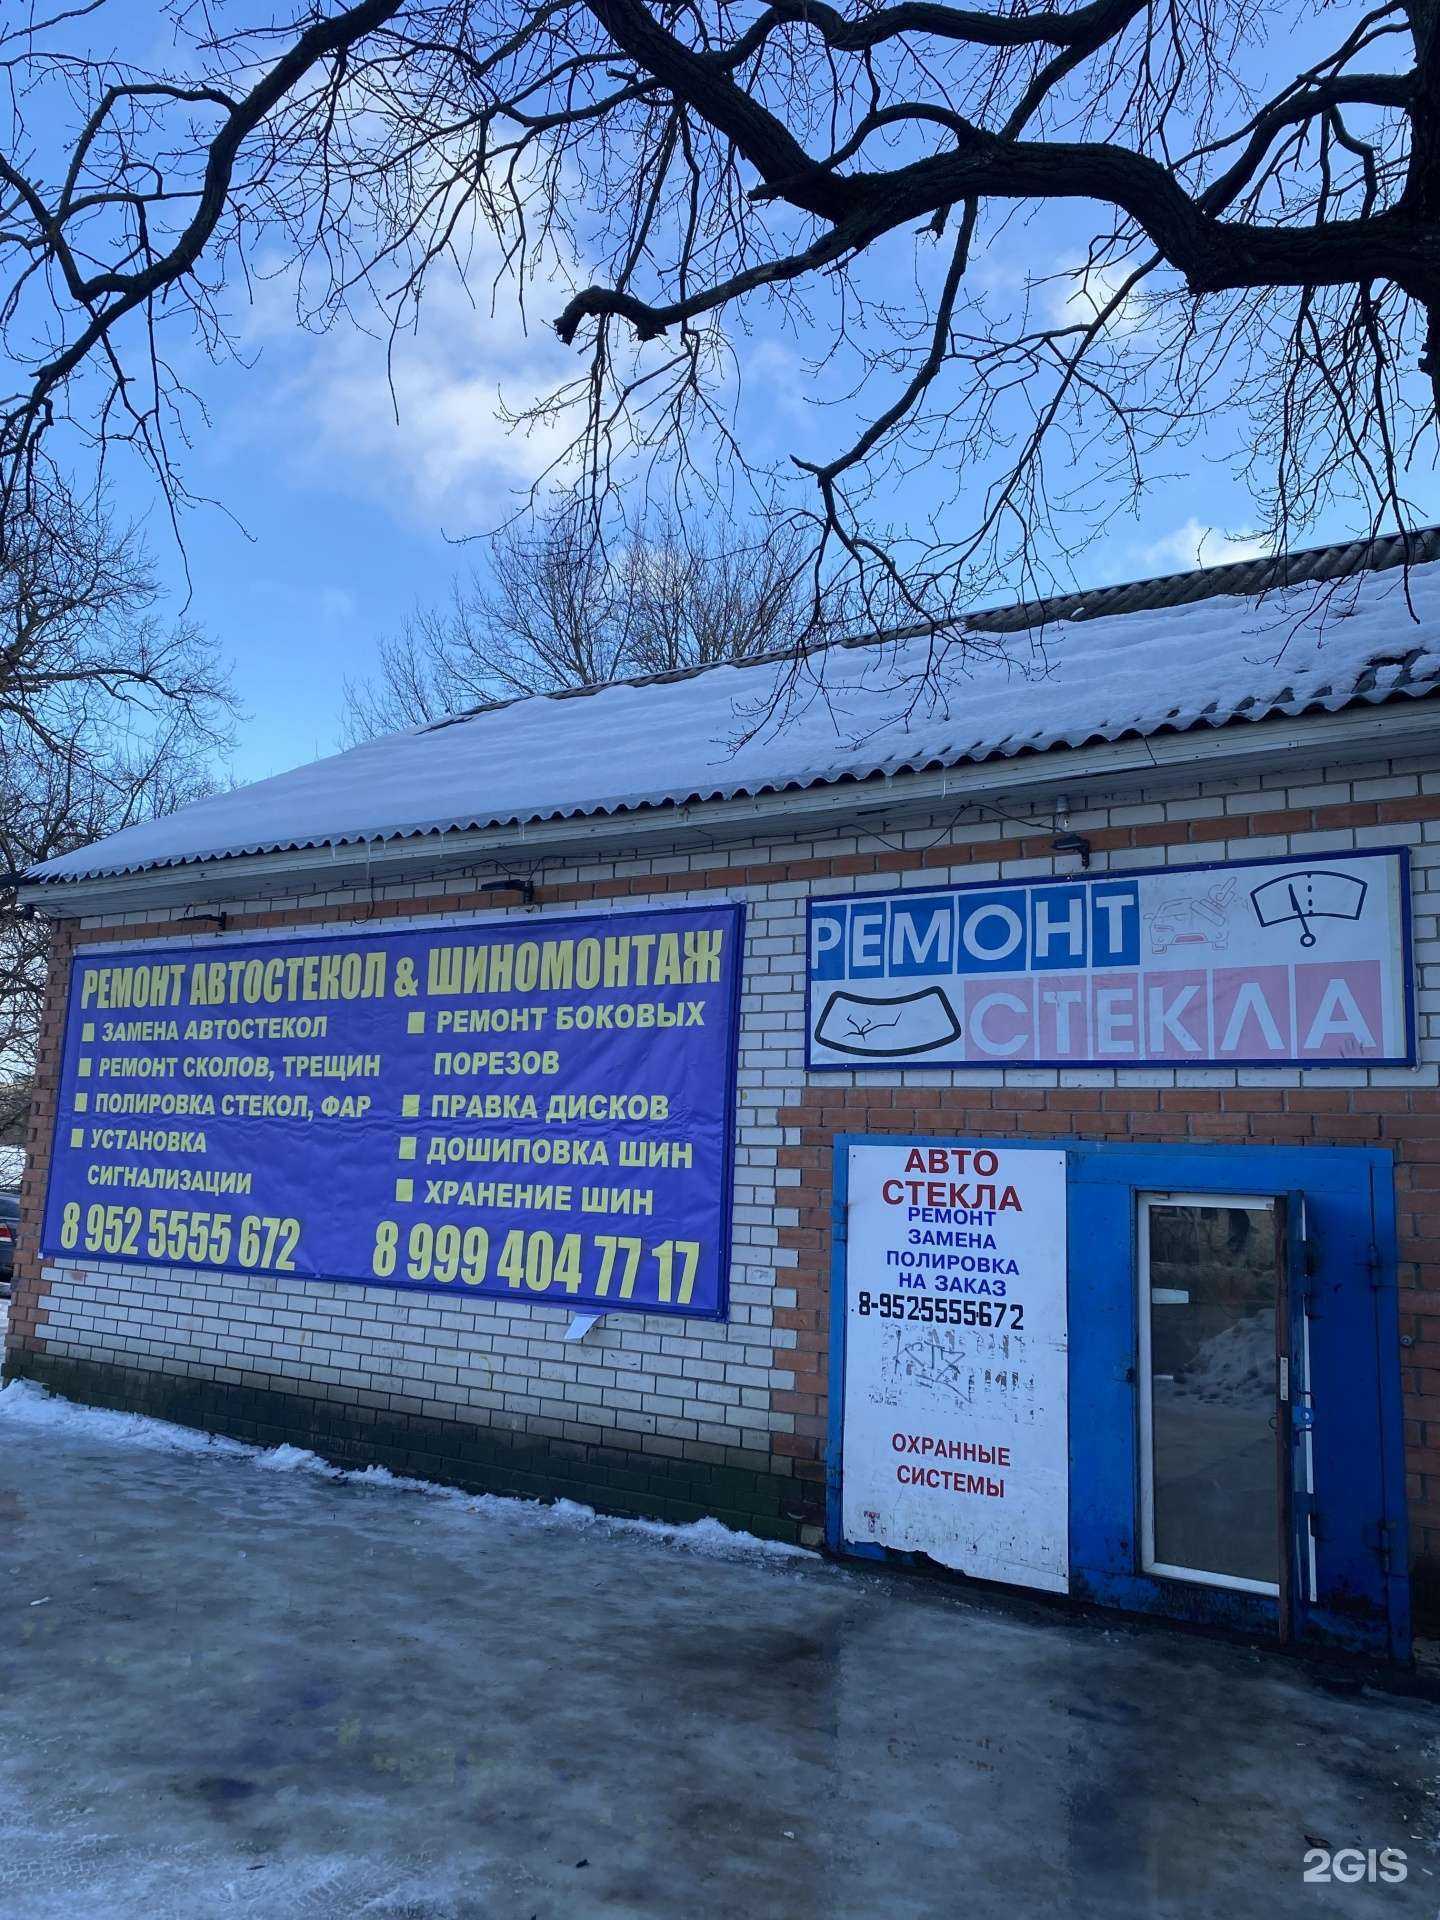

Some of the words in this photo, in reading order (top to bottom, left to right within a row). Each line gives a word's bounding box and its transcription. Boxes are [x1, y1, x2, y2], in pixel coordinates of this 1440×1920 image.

[810, 894, 1136, 970] РЕМОНТ
[80, 964, 186, 1009] РЕМОНТ
[188, 951, 387, 1005] АВТОСТЕКОЛ
[394, 957, 418, 997] &
[427, 929, 724, 996] ШИНОМОНТАЖ
[102, 1023, 179, 1042] ЗАМЕНА
[184, 1016, 328, 1040] АВТОСТЕКОЛ
[436, 1007, 547, 1033] РЕМОНТ
[556, 1001, 706, 1030] БОКОВЫХ
[968, 977, 1377, 1056] СТЕКЛА
[98, 1057, 178, 1078] РЕМОНТ
[183, 1056, 276, 1082] СКОЛОВ,
[283, 1054, 381, 1081] ТРЕЩИН
[433, 1050, 561, 1076] ПОРЕЗОВ
[95, 1093, 216, 1116] ПОЛИРОВКА
[221, 1094, 315, 1122] СТЕКОЛ,
[320, 1096, 371, 1119] ФАР
[431, 1094, 538, 1119] ПРАВКА
[545, 1094, 670, 1125] ДИСКОВ
[90, 1129, 208, 1153] УСТАНОВКА
[426, 1137, 610, 1167] ДОШИПОВКА
[618, 1141, 693, 1170] ШИН
[904, 1148, 1000, 1177] АВТО
[87, 1165, 253, 1197] СИГНАЛИЗАЦИИ
[882, 1180, 1023, 1212] СТЕКЛА
[424, 1180, 573, 1213] ХРАНЕНИЕ
[581, 1187, 654, 1216] ШИН
[908, 1207, 997, 1226] РЕМОНТ
[60, 1202, 81, 1251] 8
[84, 1204, 143, 1256] 952
[147, 1208, 233, 1265] 5555
[238, 1216, 302, 1272] 672
[908, 1229, 997, 1249] ЗАМЕНА
[372, 1220, 400, 1278] 8
[407, 1223, 490, 1286] 999
[496, 1229, 583, 1295] 404
[593, 1235, 643, 1300] 77
[651, 1239, 701, 1305] 17
[886, 1250, 1020, 1275] ПОЛИРОВКА
[899, 1272, 927, 1290] НА
[934, 1275, 1007, 1297] ЗАКАЗ
[892, 1433, 1011, 1467] ОХРАННЫЕ
[897, 1465, 1005, 1498] СИСТЕМЫ
